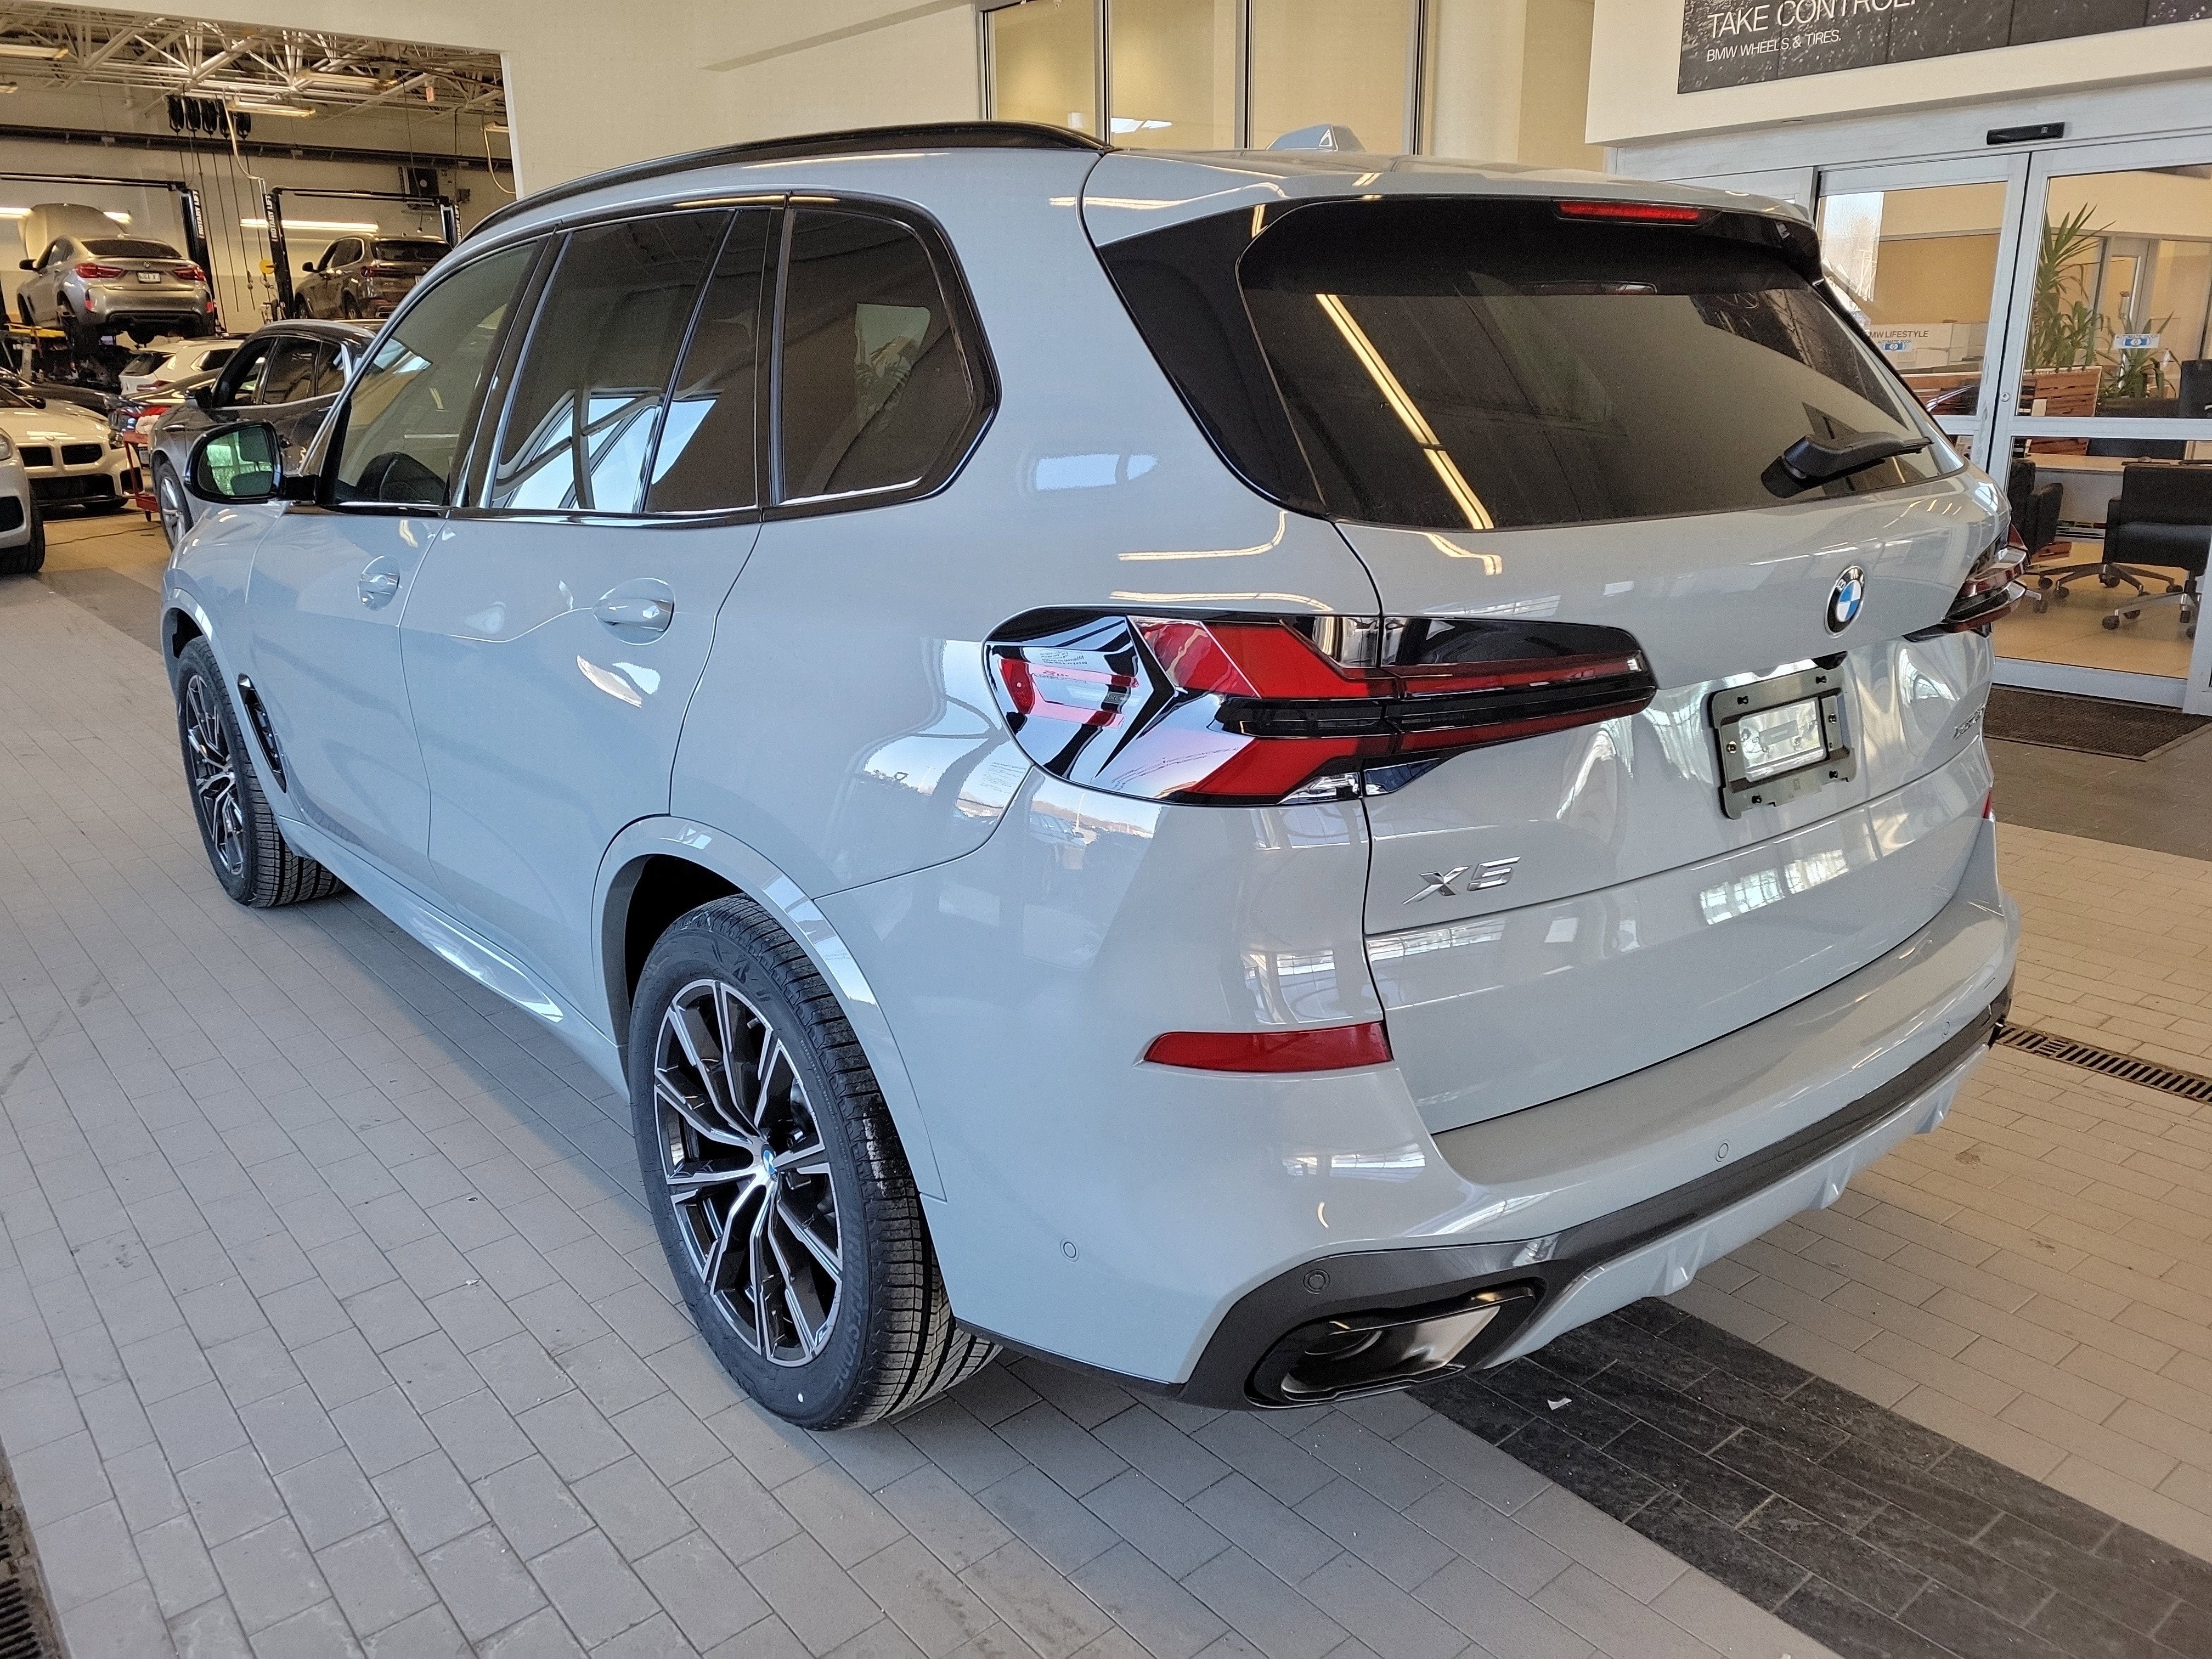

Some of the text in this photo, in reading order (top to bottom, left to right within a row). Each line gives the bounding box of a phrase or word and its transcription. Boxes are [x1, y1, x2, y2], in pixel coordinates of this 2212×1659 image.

[1707, 4, 1770, 38] TAKE
[1707, 29, 1841, 62] BMW WHEELS & TIRES.
[195, 207, 205, 235] ROTARY
[268, 211, 278, 238] ROTARY
[1402, 855, 1522, 905] X5
